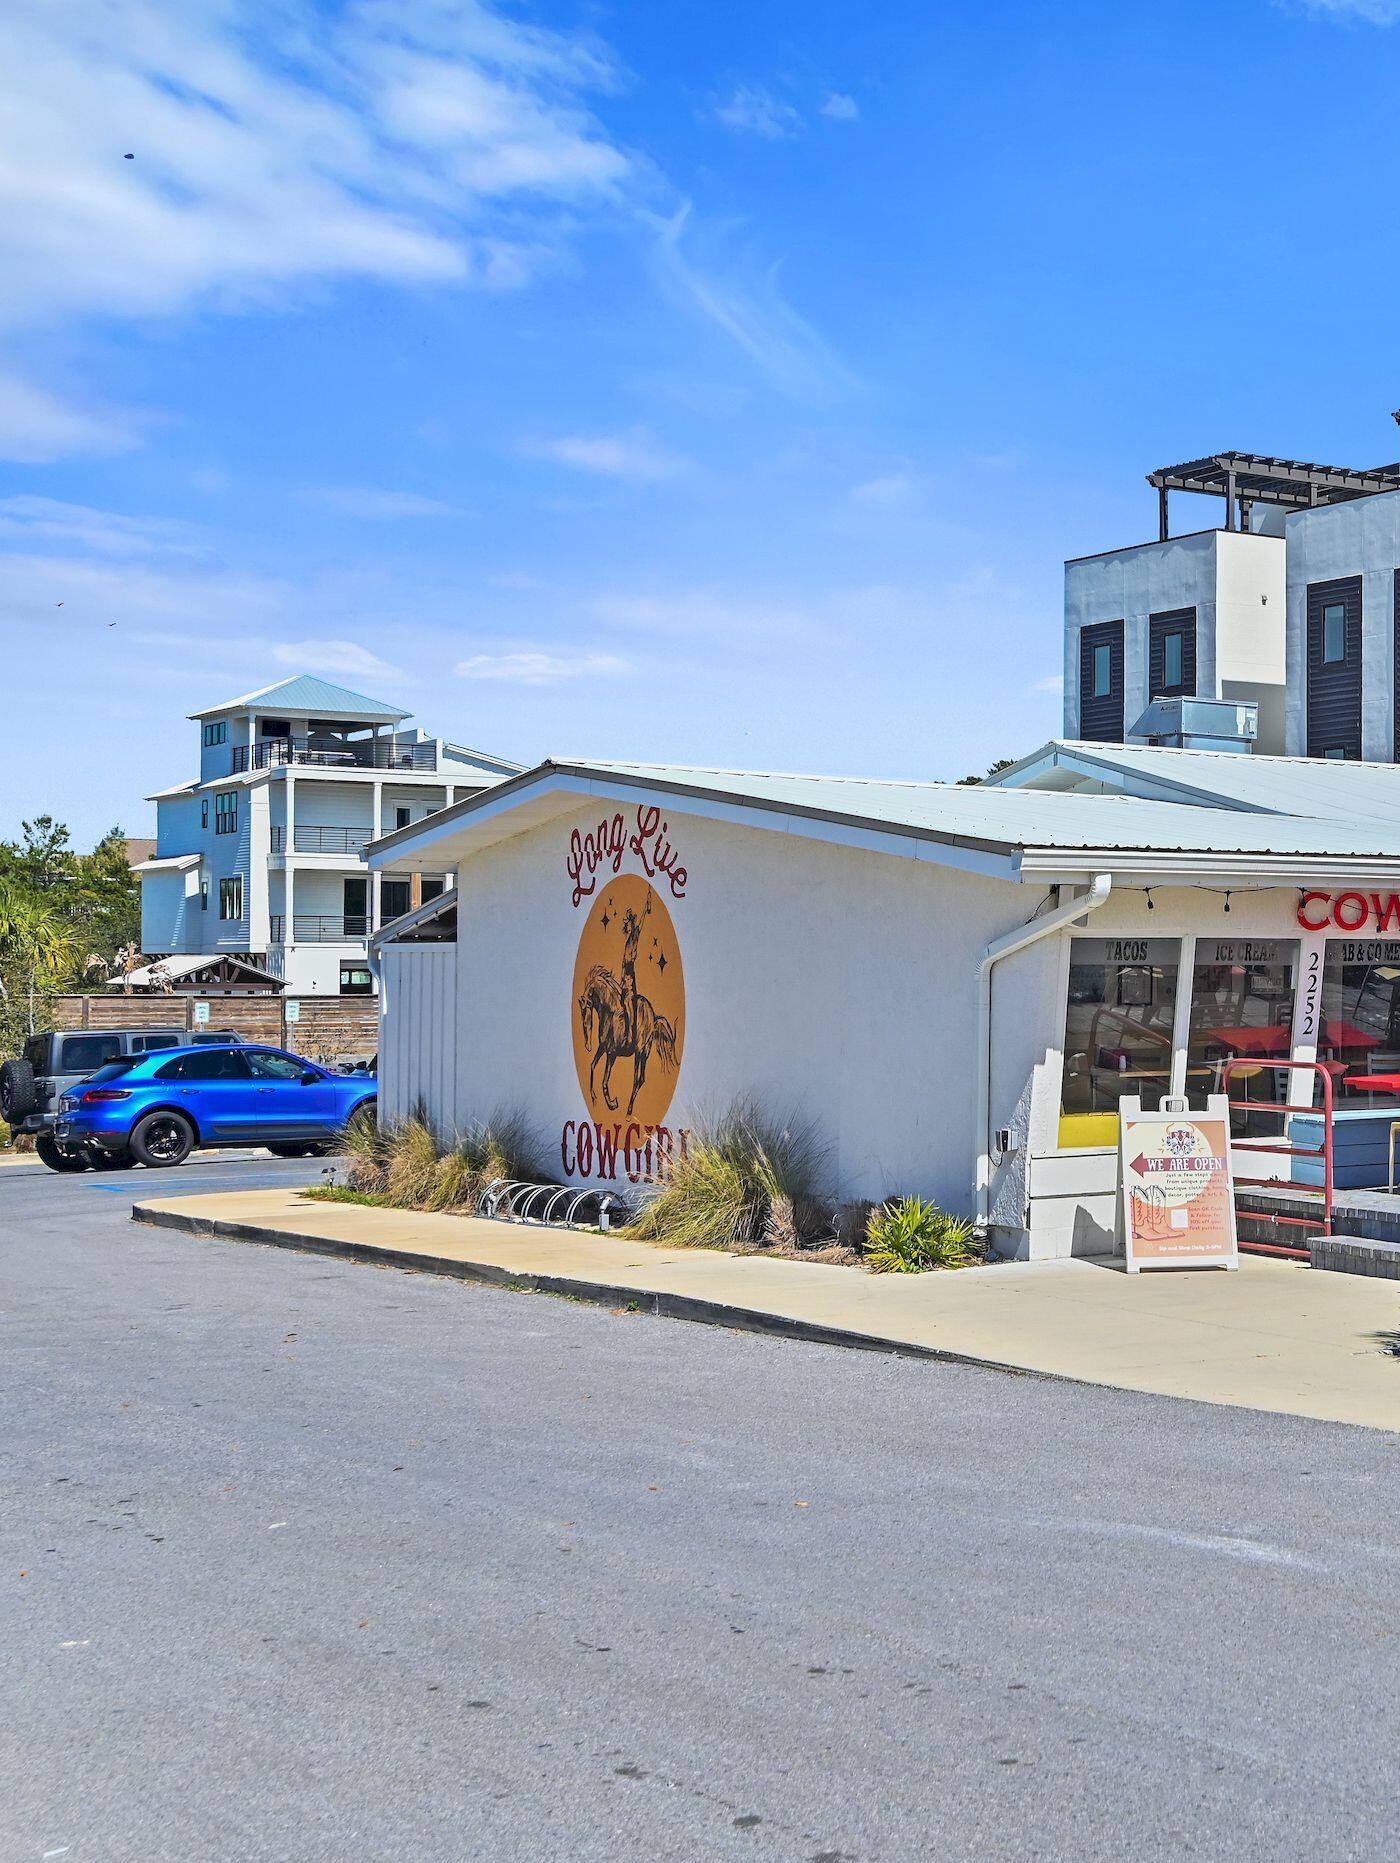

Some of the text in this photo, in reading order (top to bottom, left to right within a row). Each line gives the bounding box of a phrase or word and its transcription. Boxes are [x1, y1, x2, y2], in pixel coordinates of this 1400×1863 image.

[567, 804, 688, 908] Long Live
[1105, 941, 1148, 961] TACOS
[1215, 944, 1234, 961] ICE
[1147, 1157, 1222, 1171] WE ARE OPEN
